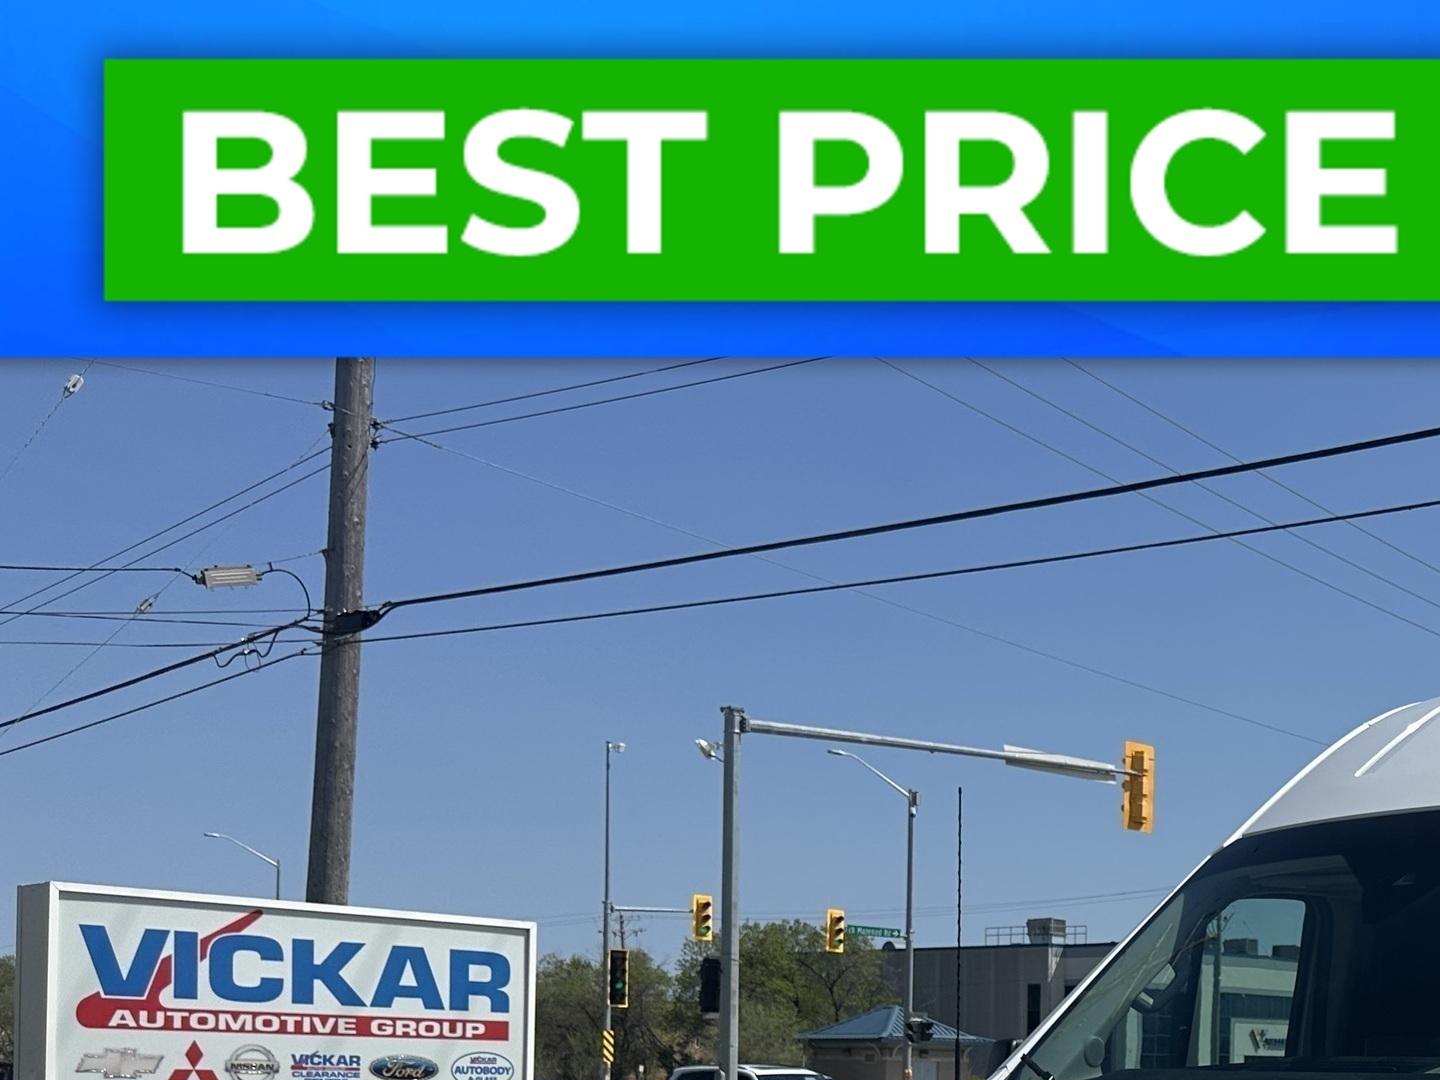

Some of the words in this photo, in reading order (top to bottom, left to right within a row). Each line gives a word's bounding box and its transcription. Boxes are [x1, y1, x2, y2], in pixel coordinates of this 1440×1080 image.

[80, 924, 511, 1013] VICKAR
[108, 1009, 356, 1034] AUTOMOTIVE
[370, 1019, 486, 1038] GROUP
[230, 1062, 275, 1071] NISSAN
[291, 1053, 361, 1067] VICKAR
[292, 1071, 360, 1079] CLEARANCE
[382, 1059, 425, 1078] Ford
[454, 1065, 513, 1075] AUTOBODY
